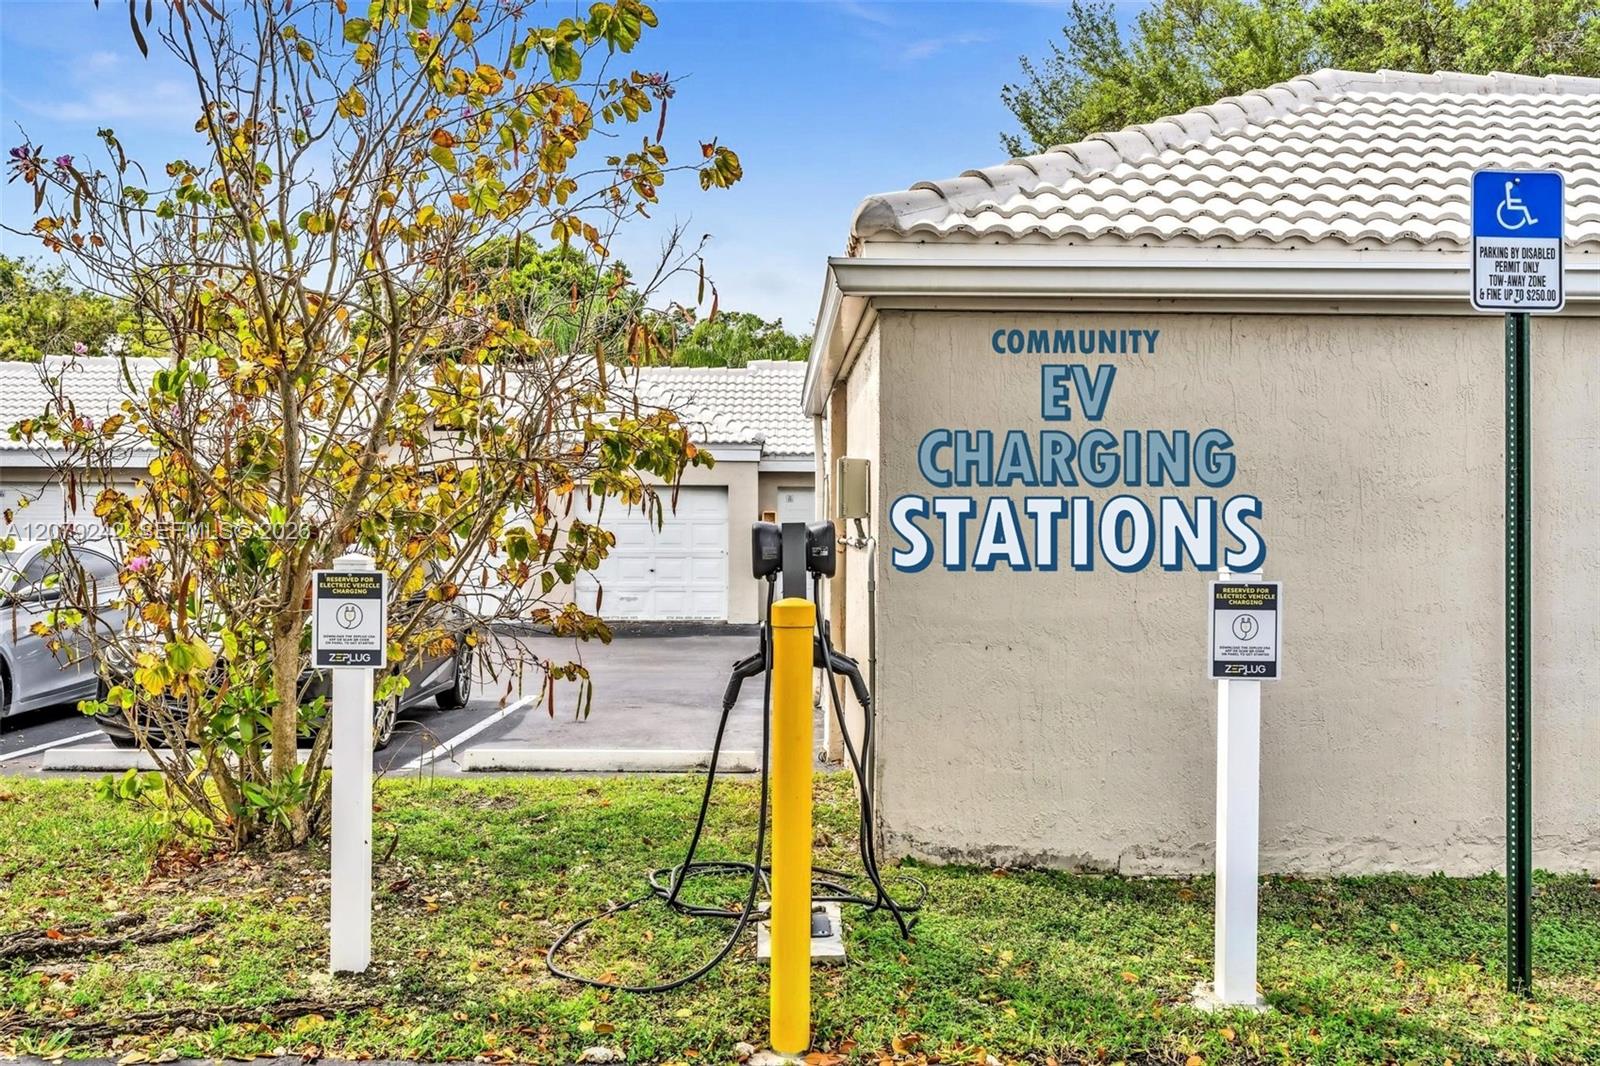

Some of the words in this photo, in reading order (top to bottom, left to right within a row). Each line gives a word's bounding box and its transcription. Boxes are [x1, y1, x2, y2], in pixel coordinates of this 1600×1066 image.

[1480, 246, 1508, 258] PARKING
[1510, 247, 1519, 259] BY
[1522, 248, 1556, 260] DISABLED
[1494, 261, 1520, 272] PERMIT
[1522, 262, 1540, 273] ONLY
[1488, 274, 1526, 286] TOW-AWAY
[1528, 276, 1546, 287] ZONE
[1480, 289, 1484, 300] &
[1486, 289, 1502, 300] FINE
[1504, 289, 1514, 300] UP
[1515, 289, 1524, 300] TO
[1526, 289, 1556, 301] $250.00
[328, 653, 371, 662] ZEPLUG
[1225, 664, 1266, 674] ZEPLUG
